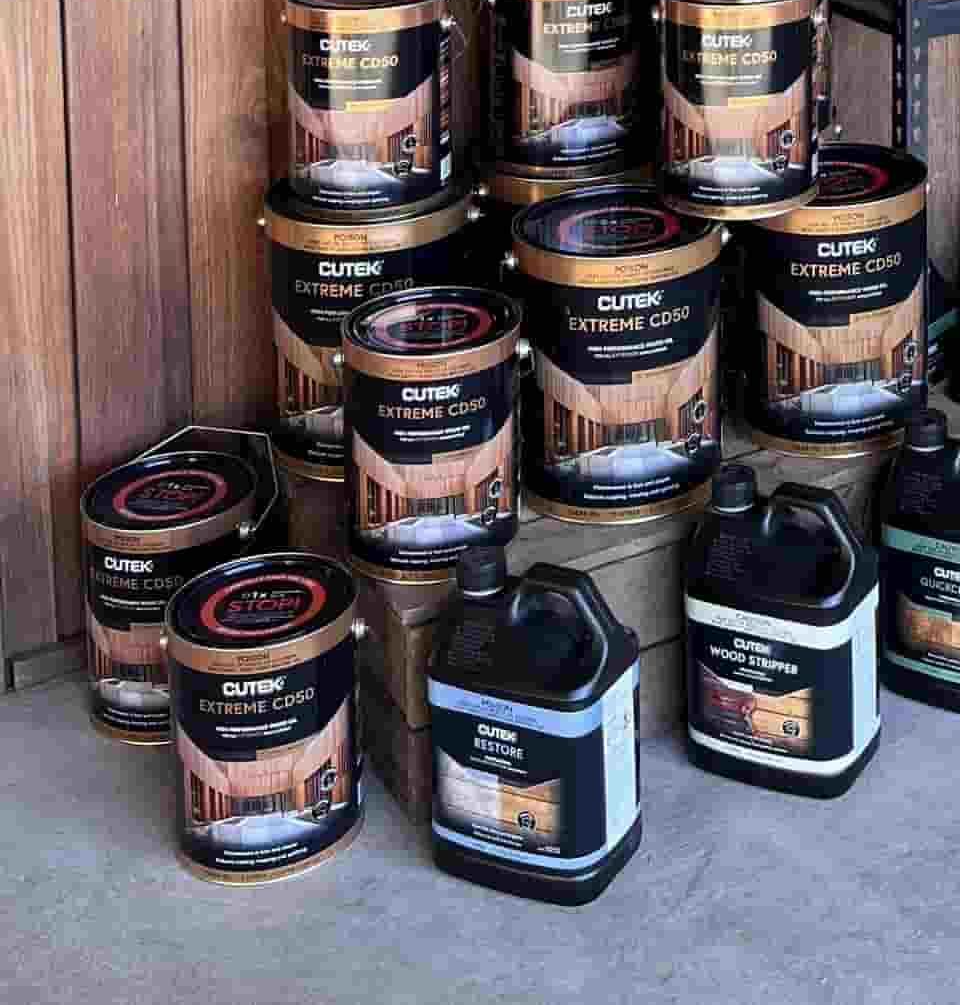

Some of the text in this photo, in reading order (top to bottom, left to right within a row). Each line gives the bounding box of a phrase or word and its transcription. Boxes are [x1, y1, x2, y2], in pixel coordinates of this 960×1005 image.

[566, 1, 613, 19] CUTEK
[319, 38, 371, 52] CUTEK
[702, 33, 753, 49] CUTEK
[302, 54, 399, 68] EXTREME CD50
[741, 49, 778, 67] CD50
[817, 236, 878, 258] CUTEK
[318, 258, 385, 278] CUTEK
[790, 251, 902, 279] EXTREME CD50
[295, 275, 415, 298] EXTREME CD50
[597, 289, 665, 312] CUTEK
[568, 305, 690, 333] EXTREME CD50
[401, 383, 461, 402] CUTEK
[376, 396, 488, 420] EXTREME CD50
[103, 556, 153, 574] CUTEK
[733, 637, 772, 655] CUTEK
[709, 644, 747, 665] WOOD
[748, 653, 799, 676] STRIPPER
[222, 675, 288, 697] CUTEK
[199, 686, 315, 716] EXTREME CD50
[477, 723, 519, 744] CUTEK
[473, 737, 526, 761] RESTORE
